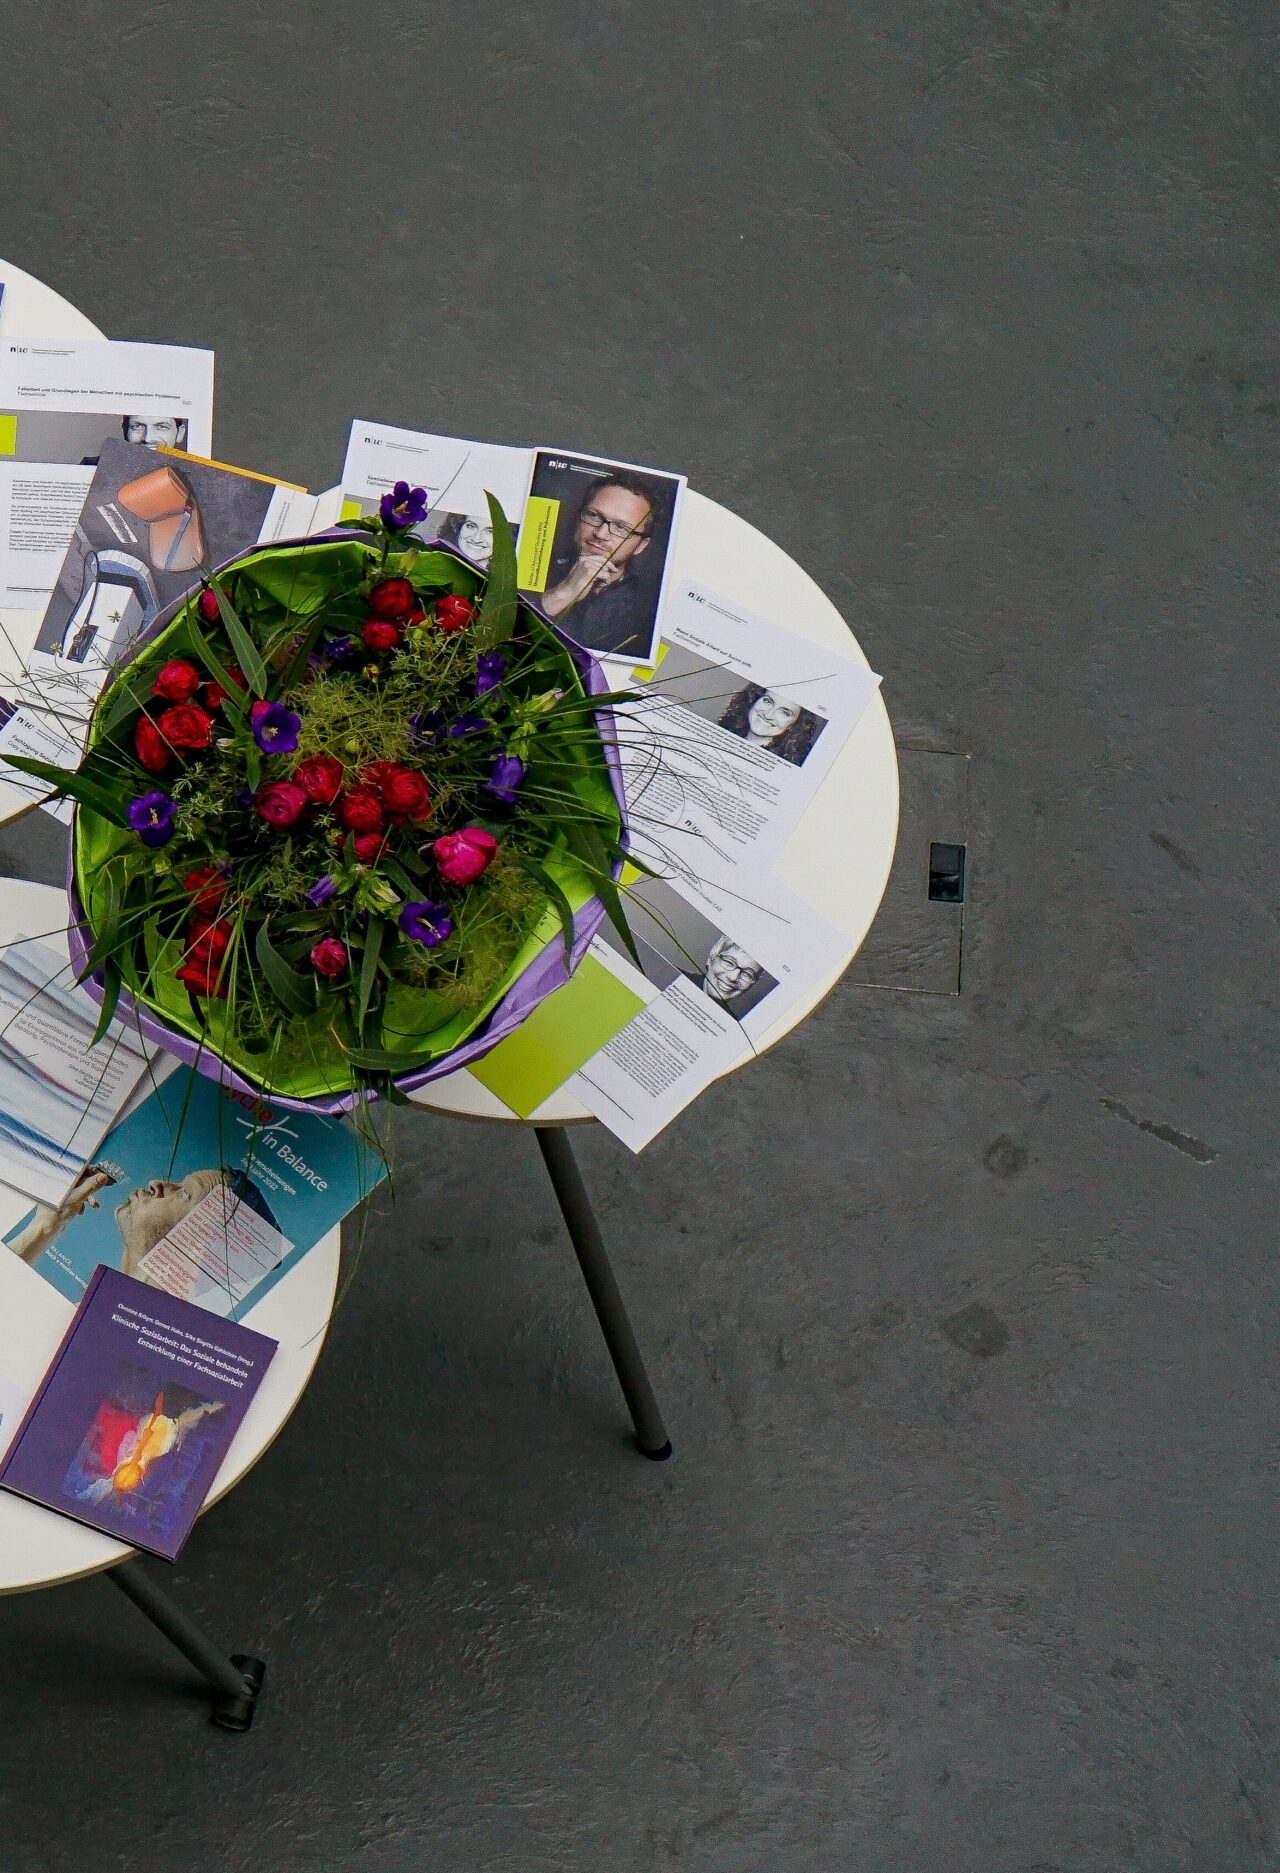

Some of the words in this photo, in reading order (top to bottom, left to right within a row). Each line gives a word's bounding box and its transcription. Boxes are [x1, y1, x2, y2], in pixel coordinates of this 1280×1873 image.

[7, 740, 21, 751] Copy
[11, 734, 39, 755] Fachtagung
[39, 752, 57, 766] Soziale
[24, 1011, 37, 1021] und
[261, 1130, 280, 1149] in
[277, 1142, 329, 1192] Balance
[262, 1176, 278, 1191] 2022
[117, 1302, 138, 1315] Christine
[184, 1332, 196, 1341] Silke
[111, 1313, 140, 1331] Klinische
[140, 1324, 179, 1348] Sozialarbeit:
[180, 1341, 192, 1354] Das
[192, 1348, 215, 1364] Soziale
[215, 1358, 248, 1378] behandeln
[137, 1337, 176, 1360] Entwicklung
[176, 1353, 193, 1368] einer
[193, 1360, 244, 1389] Fachsozialarbeit
